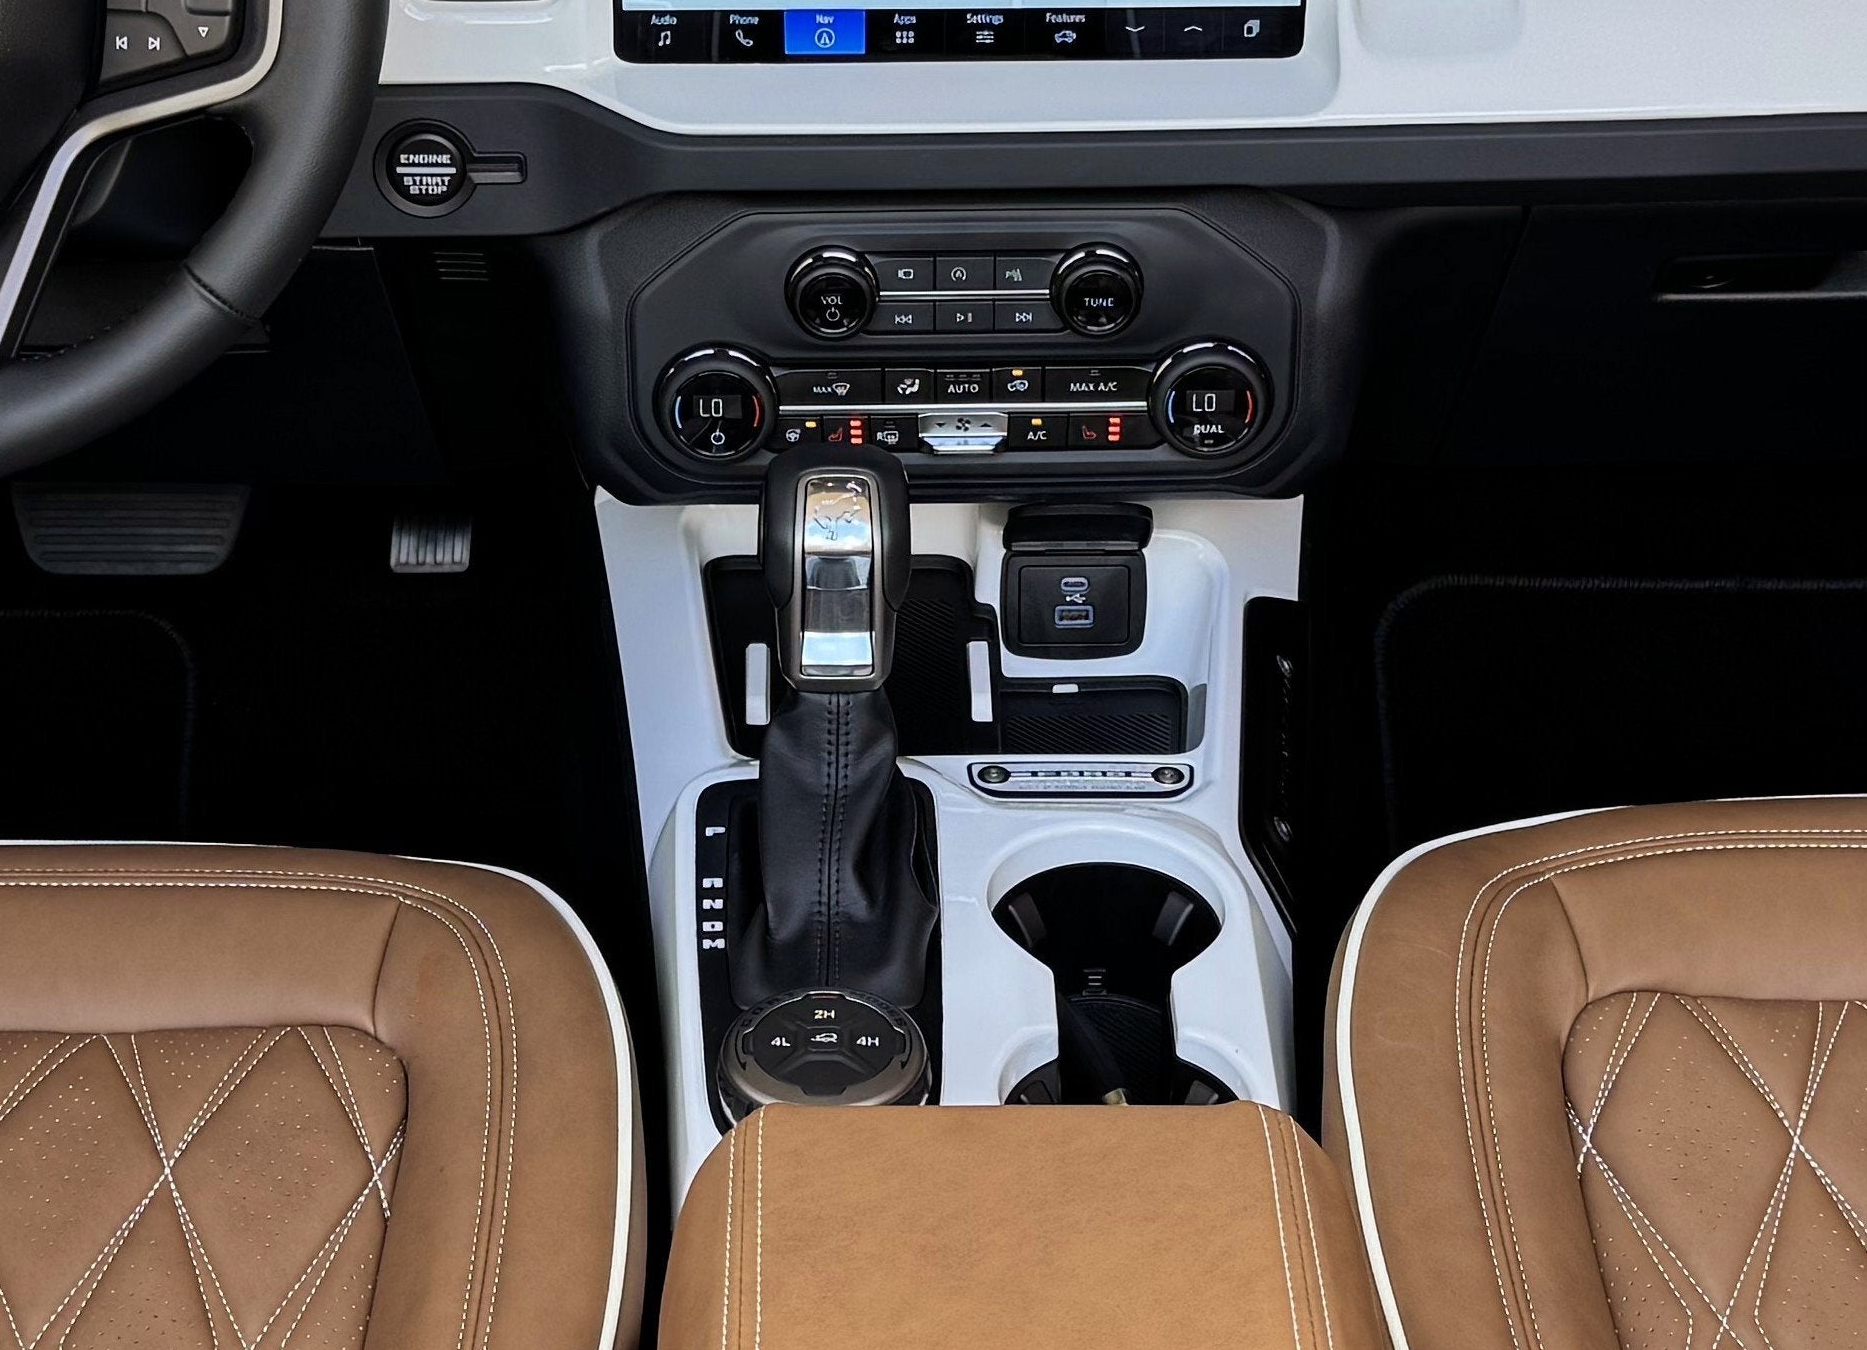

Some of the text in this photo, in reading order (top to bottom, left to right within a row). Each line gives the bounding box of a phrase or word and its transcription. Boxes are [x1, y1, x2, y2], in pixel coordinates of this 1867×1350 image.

[729, 13, 759, 25] Phone
[815, 14, 835, 25] Nav
[403, 176, 452, 186] START
[409, 185, 448, 195] STOP
[820, 295, 844, 306] VOL
[1084, 297, 1114, 307] TUNE
[947, 383, 979, 394] AUTO
[1070, 381, 1118, 392] MAX A/C
[1193, 423, 1225, 434] DUAL
[1027, 430, 1047, 442] A/C
[702, 898, 724, 909] N
[702, 938, 725, 949] M
[814, 1009, 835, 1020] 2H
[770, 1036, 791, 1047] 4L
[856, 1036, 880, 1047] 4H
